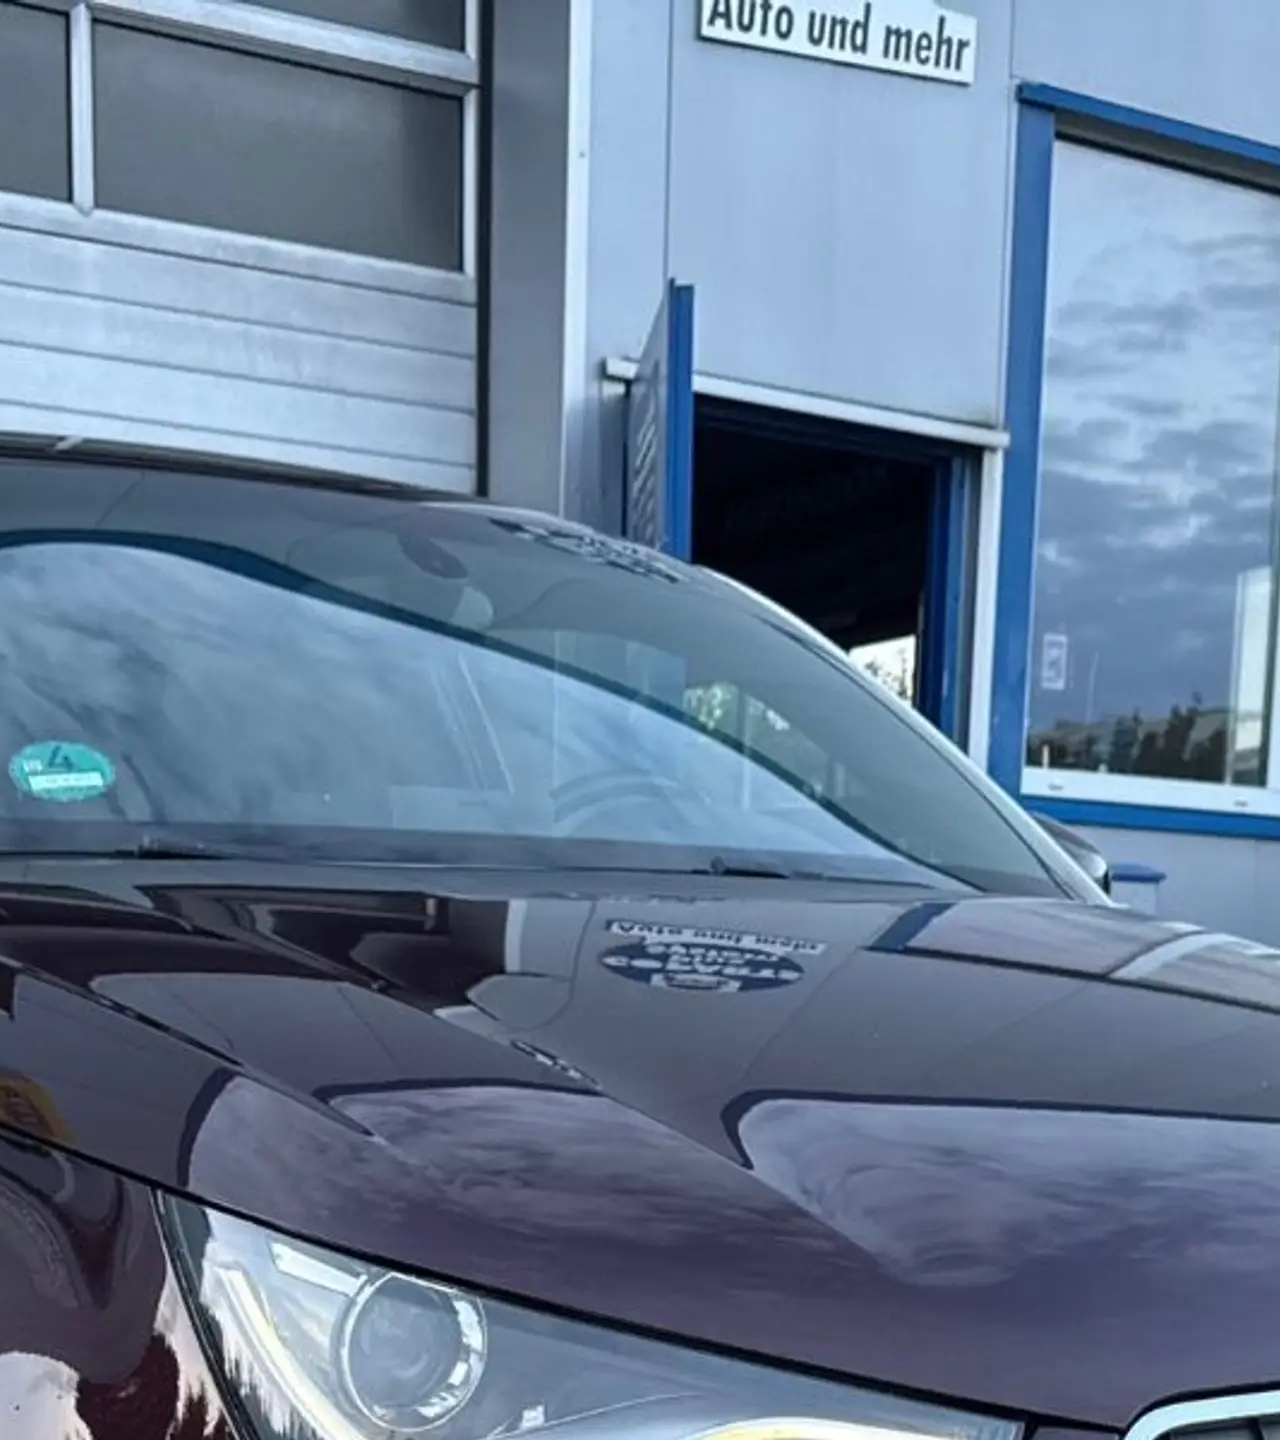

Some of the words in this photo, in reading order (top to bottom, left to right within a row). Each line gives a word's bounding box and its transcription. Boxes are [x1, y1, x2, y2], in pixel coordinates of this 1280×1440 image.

[707, 0, 794, 40] Auto
[807, 2, 871, 54] und
[883, 15, 970, 71] mehr
